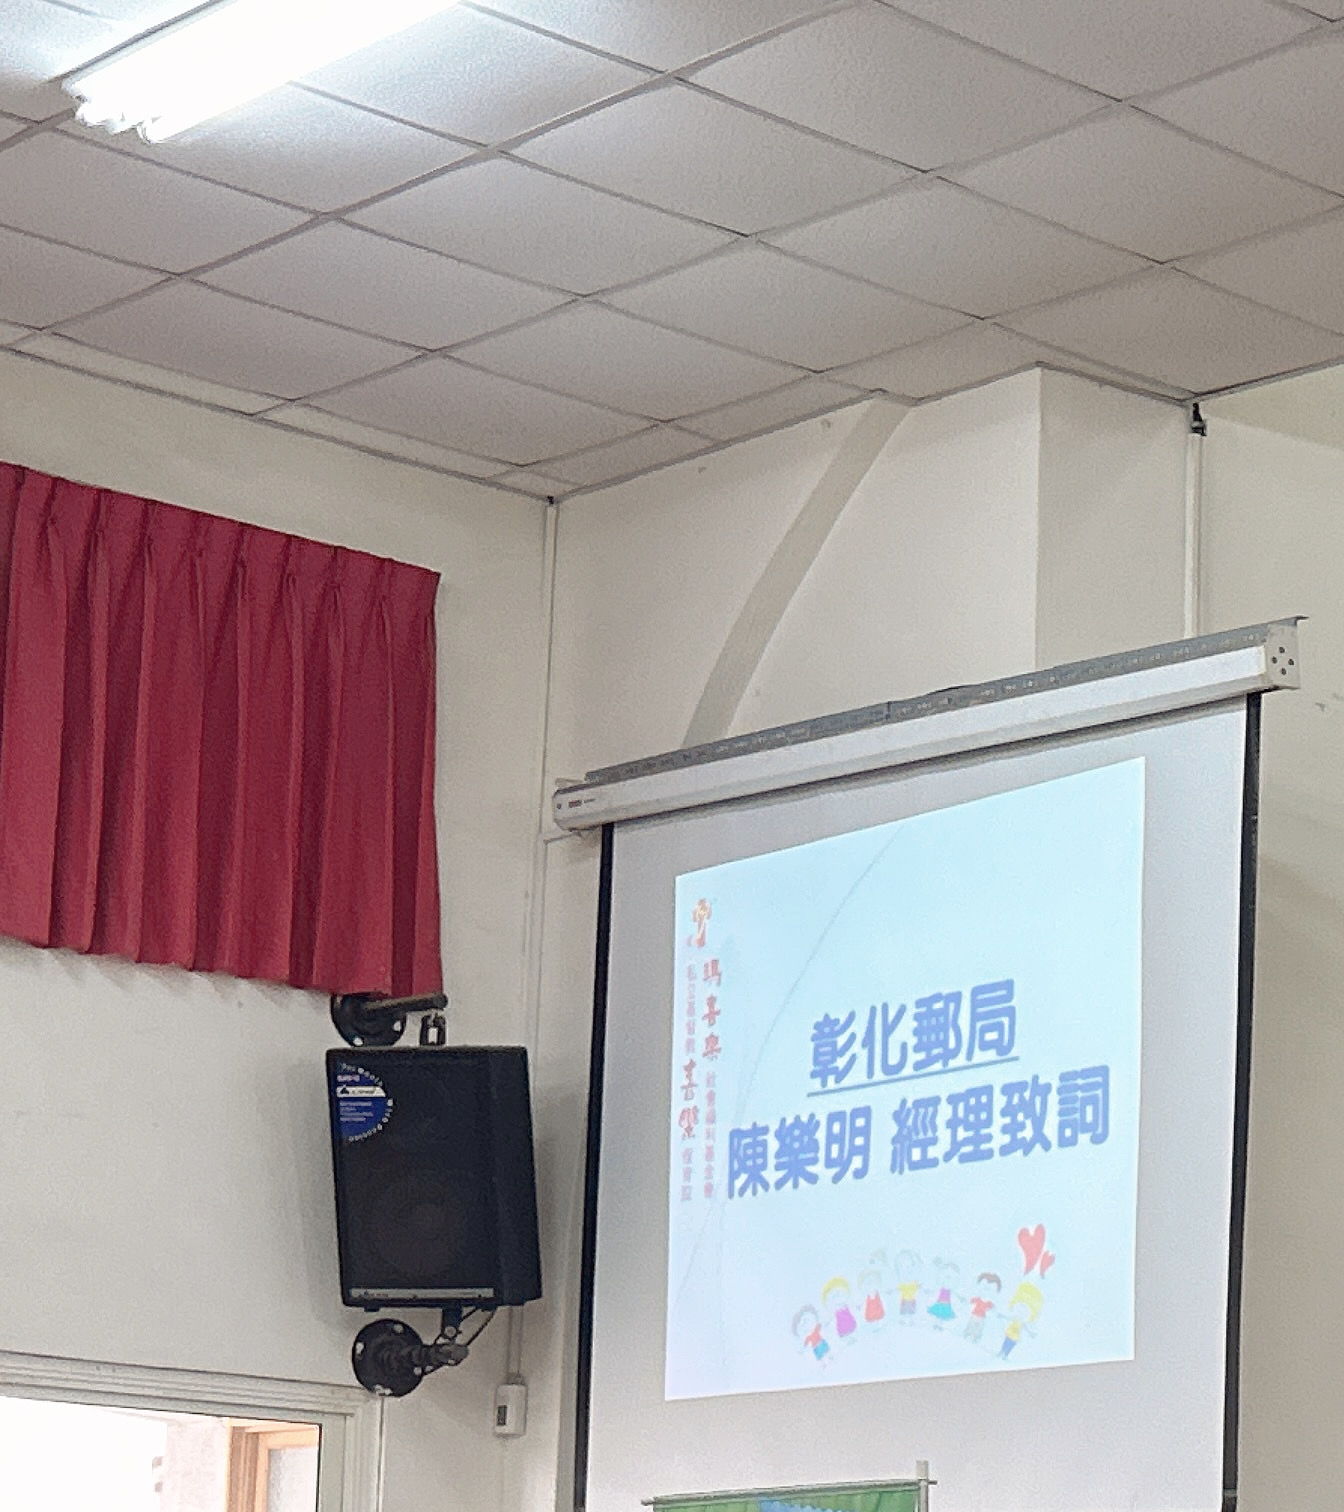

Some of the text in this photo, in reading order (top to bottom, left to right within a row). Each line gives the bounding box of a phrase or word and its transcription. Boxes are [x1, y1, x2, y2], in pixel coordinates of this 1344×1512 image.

[809, 978, 1017, 1088] 彰化郵局
[727, 1064, 1111, 1199] 陳樂明 經理致詞
